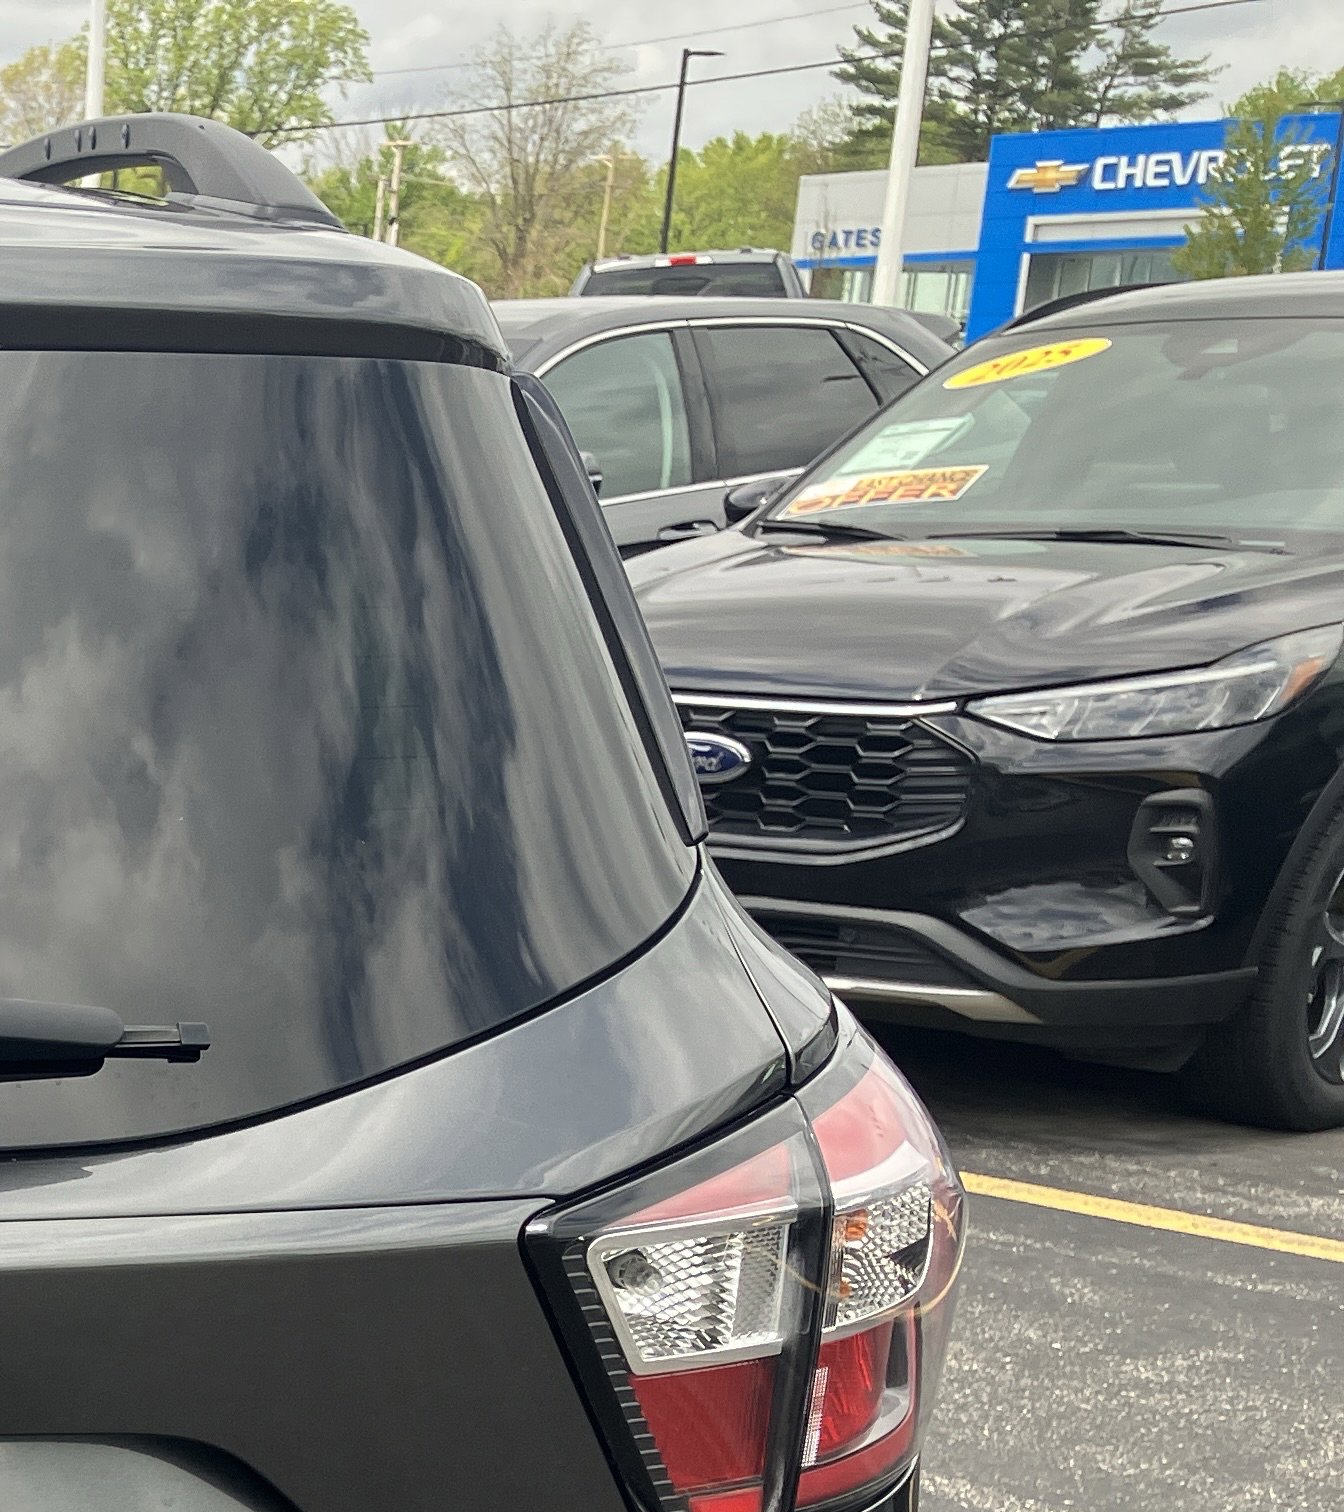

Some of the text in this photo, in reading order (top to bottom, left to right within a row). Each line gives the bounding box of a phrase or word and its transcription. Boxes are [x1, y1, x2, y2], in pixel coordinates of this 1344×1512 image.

[812, 227, 881, 250] GATES
[968, 343, 1081, 383] 2025
[789, 484, 960, 513] OFFER
